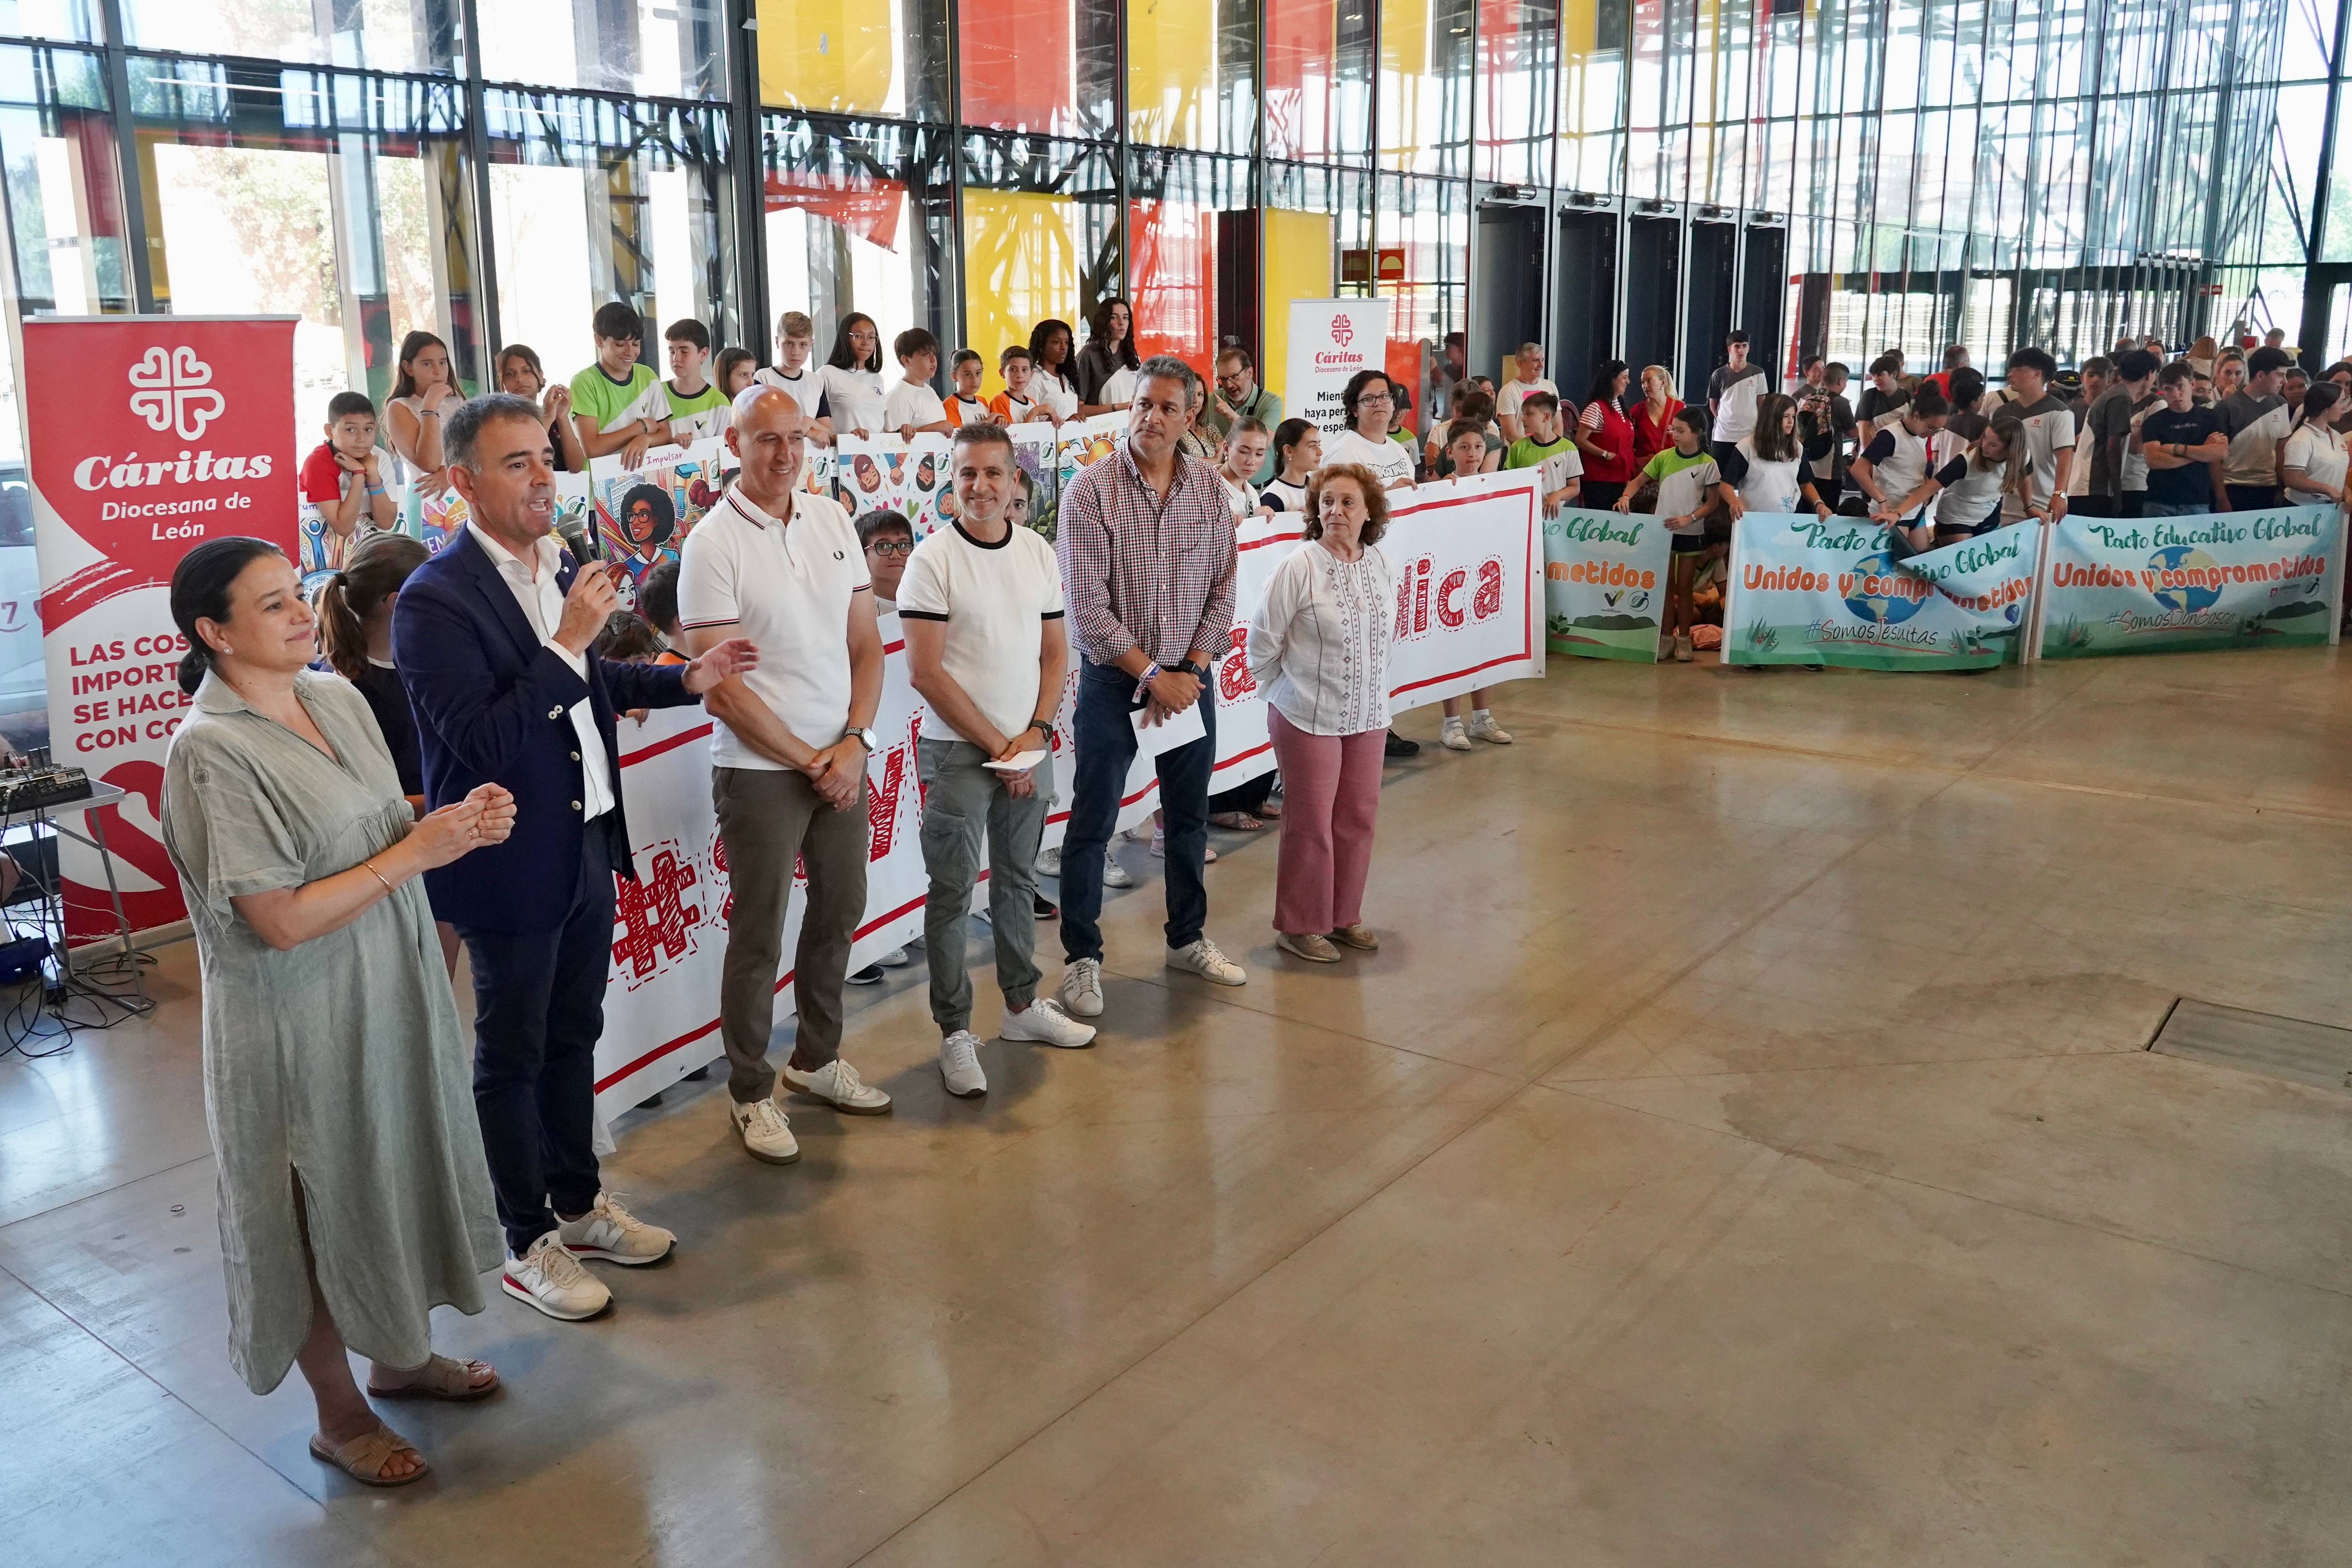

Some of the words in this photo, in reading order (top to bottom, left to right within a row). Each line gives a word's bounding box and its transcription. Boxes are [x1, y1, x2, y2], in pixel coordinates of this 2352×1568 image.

[1315, 351, 1363, 364] Cáritas
[1318, 391, 1345, 401] Mient
[1305, 408, 1326, 420] haya
[73, 450, 272, 491] Cáritas
[646, 452, 683, 466] Impulsar
[102, 497, 217, 521] Diocesana
[225, 492, 251, 509] de
[152, 521, 205, 541] León
[1567, 517, 1643, 546] Global
[2088, 525, 2148, 549] Pacto
[2154, 522, 2247, 547] Educativo
[2253, 513, 2322, 541] Global
[1791, 522, 1866, 551] Pacto
[1955, 533, 2020, 574] Global
[1547, 561, 1655, 589] metidos
[1744, 564, 1829, 592] Unidos
[1838, 574, 1854, 598] y
[2053, 563, 2136, 587] Unidos
[2142, 570, 2154, 592] y
[2161, 554, 2325, 591] comprometidos
[1807, 619, 1938, 645] #SomosJesuitas
[2107, 609, 2235, 631] #SomosDonBosco
[70, 641, 125, 666] LAS
[134, 635, 191, 654] COS
[73, 664, 179, 695] IMPORT
[74, 701, 109, 724] SE
[118, 692, 192, 716] HACE
[76, 725, 137, 752] CON
[146, 720, 183, 738] CO
